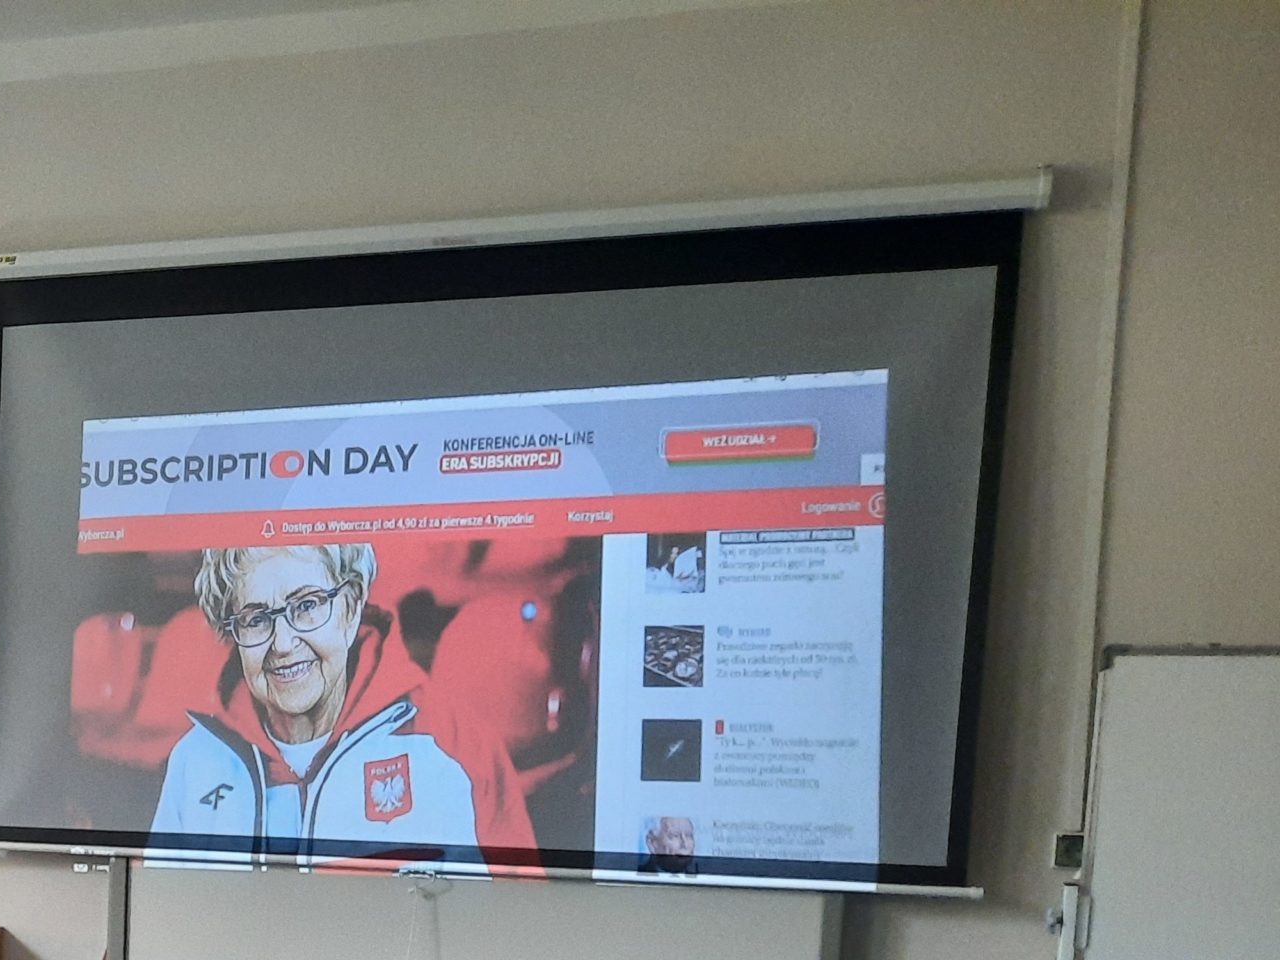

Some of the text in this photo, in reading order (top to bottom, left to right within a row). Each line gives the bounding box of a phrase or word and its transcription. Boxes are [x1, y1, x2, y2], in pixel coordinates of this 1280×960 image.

[443, 430, 595, 452] KONFERENCJA ON-LINE
[343, 443, 419, 475] DAY
[441, 451, 559, 471] ERA SUBSKRYPCJI
[568, 511, 614, 524] Korzystaj
[801, 501, 862, 515] Logowanie
[282, 521, 313, 535] Dostęp
[314, 521, 326, 532] do
[327, 518, 382, 534] Wyborcza.pl
[383, 518, 396, 529] od
[397, 518, 417, 530] 4,90
[418, 517, 428, 528] zł
[428, 518, 440, 528] za
[441, 514, 483, 529] pierwsze
[484, 513, 492, 525] 4
